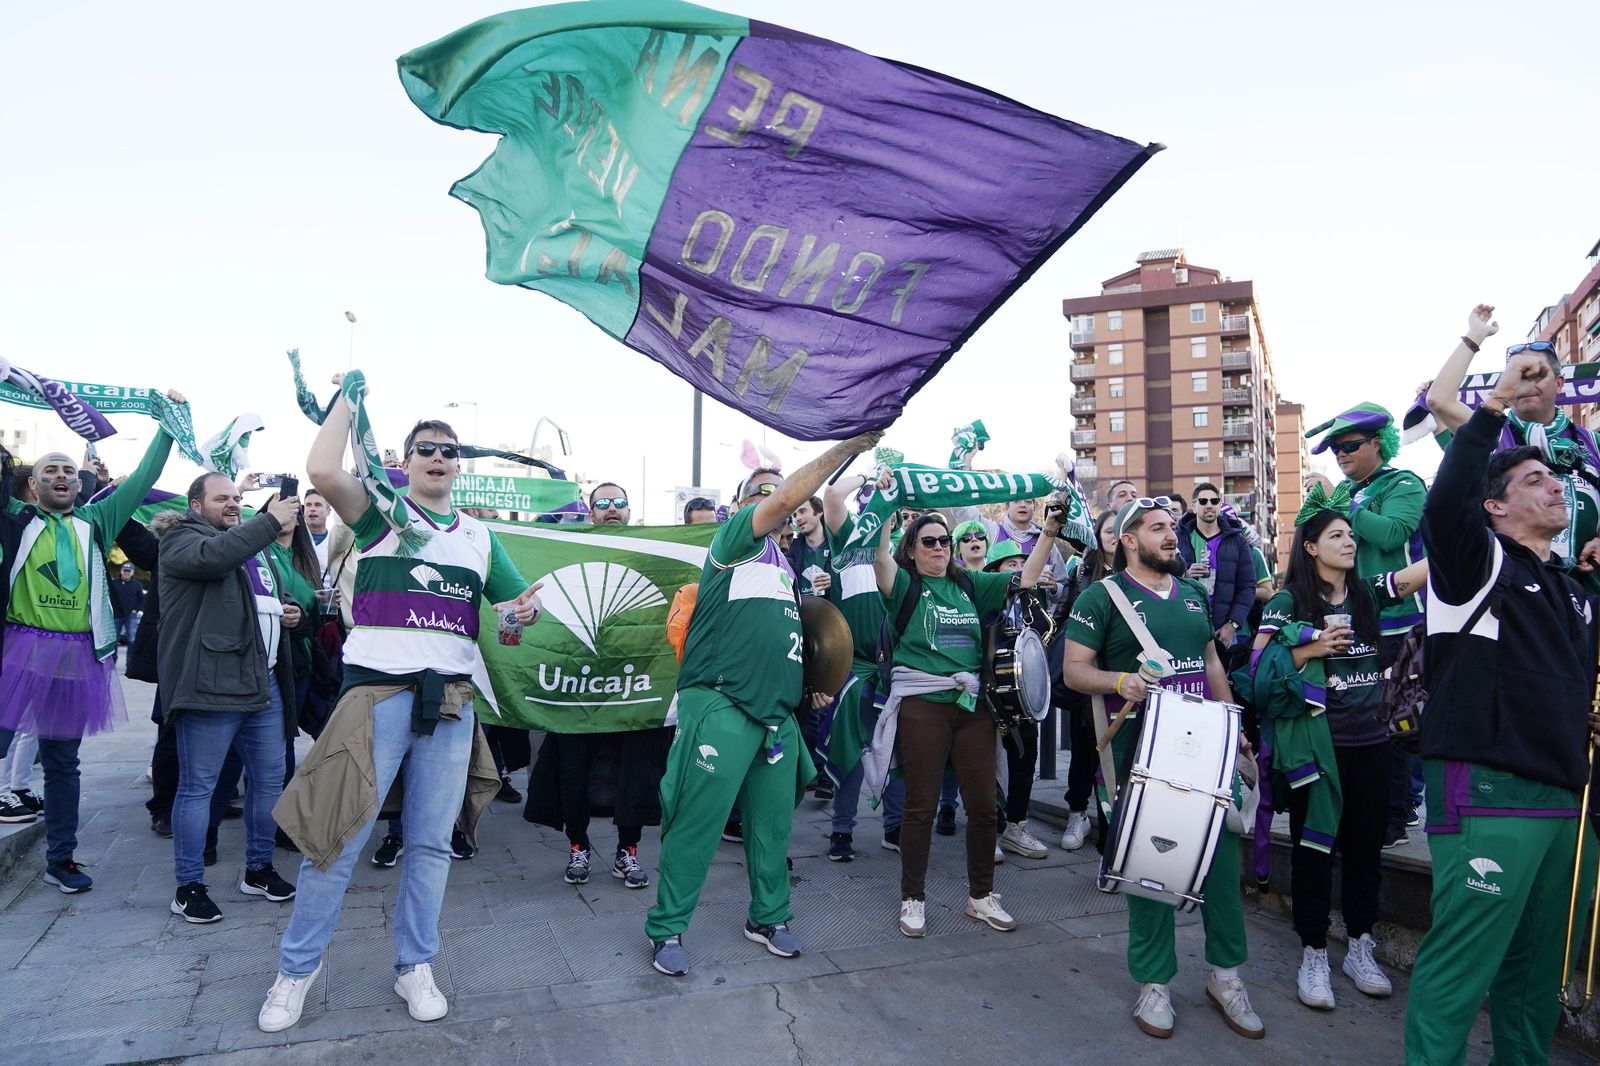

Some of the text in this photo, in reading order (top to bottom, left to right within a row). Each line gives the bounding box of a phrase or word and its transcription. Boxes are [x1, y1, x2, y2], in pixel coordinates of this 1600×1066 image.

[70, 382, 150, 400] icaja
[97, 400, 117, 409] REY
[121, 400, 146, 409] 2005
[880, 467, 1033, 501] Unicaja
[450, 491, 531, 510] LONCESTO
[539, 663, 652, 699] Unicaja
[1346, 671, 1379, 685] MÁLAG
[696, 758, 715, 771] Unicaja
[1467, 877, 1501, 893] Unicaja
